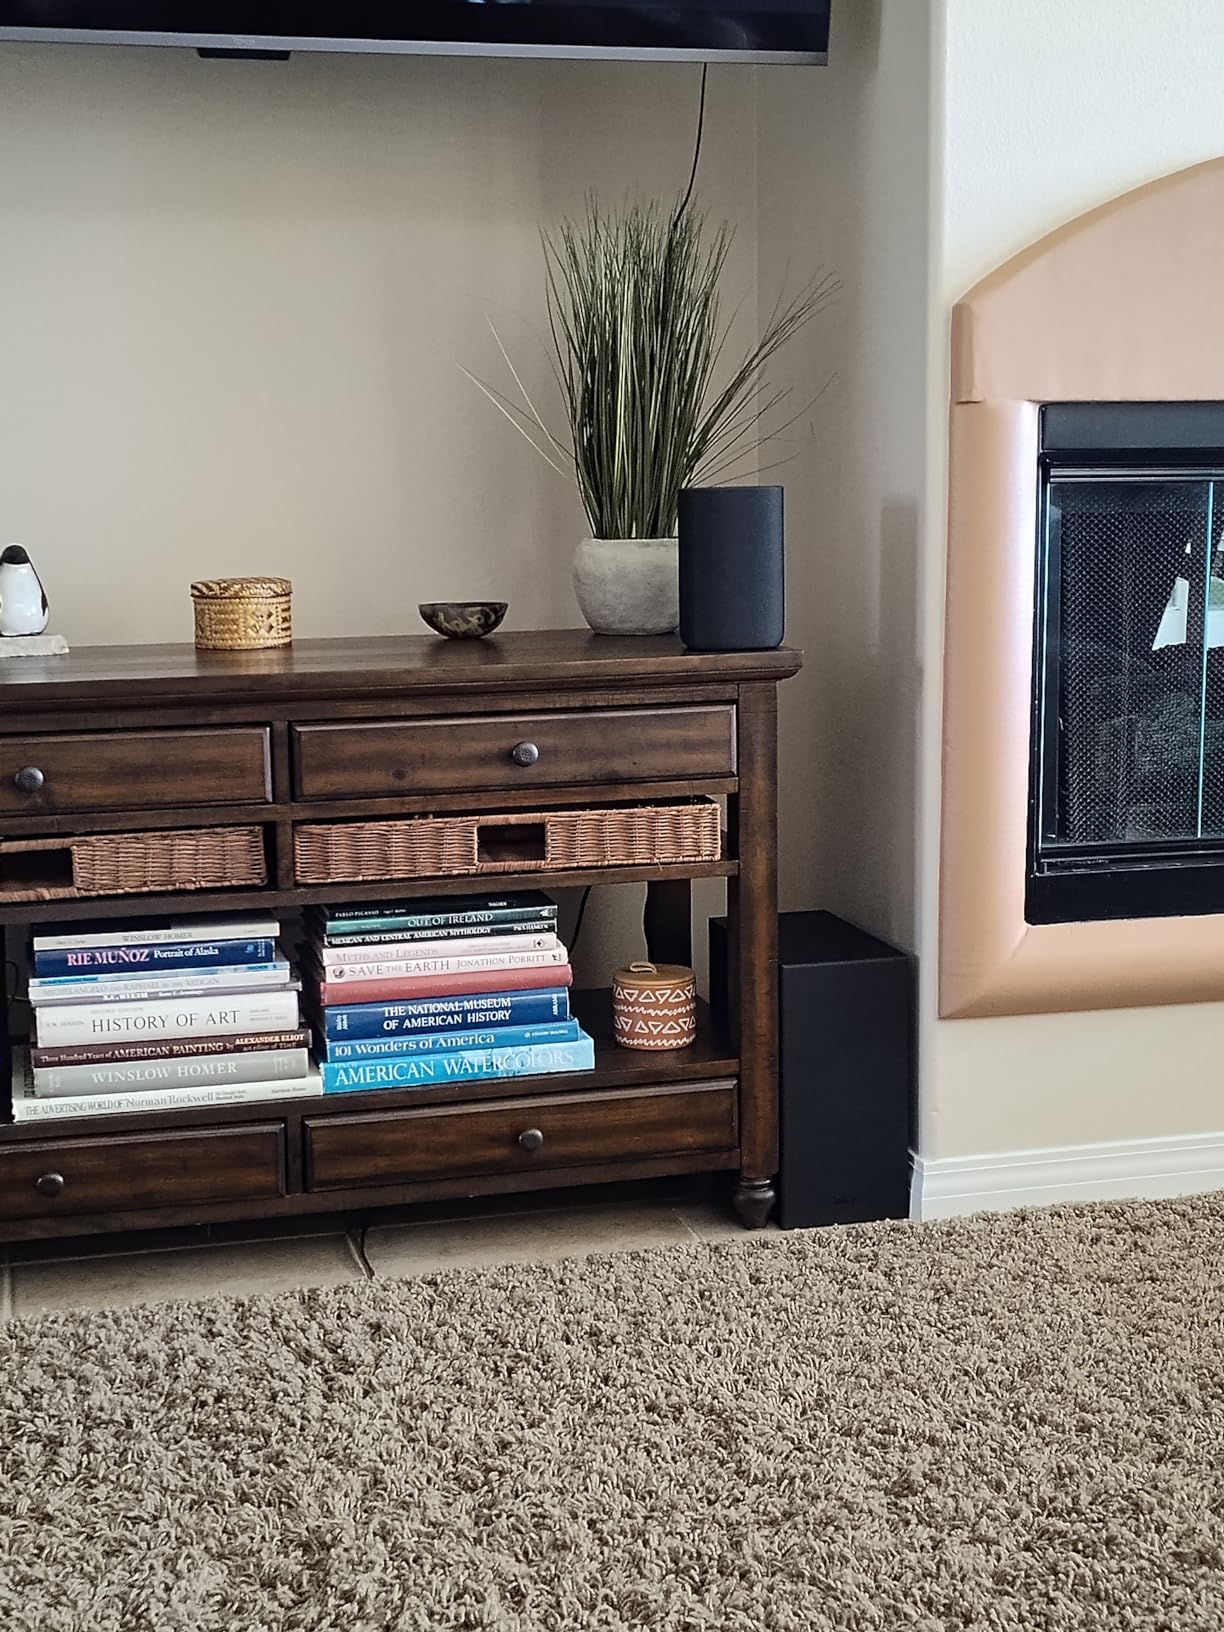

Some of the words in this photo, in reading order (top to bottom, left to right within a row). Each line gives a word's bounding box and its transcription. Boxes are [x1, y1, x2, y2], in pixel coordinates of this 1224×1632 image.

[354, 909, 380, 917] PICASSO
[407, 917, 431, 928] OUT
[431, 917, 446, 925] OF
[448, 913, 494, 924] IRELAND
[122, 934, 161, 942] WINSLOW
[164, 932, 193, 941] HOMER
[331, 936, 361, 945] MEXICAN
[363, 935, 380, 943] AND
[381, 932, 412, 942] CENTRAL
[412, 929, 448, 940] AMERICAN
[449, 926, 492, 937] MYTHOLOGY
[67, 952, 93, 966] RIE
[94, 947, 150, 964] MUÑOZ
[153, 949, 185, 959] Portrait
[185, 947, 195, 957] of
[194, 947, 219, 956] Alaska
[456, 957, 507, 969] JONATHON
[508, 954, 545, 964] PORRITT
[348, 964, 384, 977] SAVE
[386, 964, 404, 973] THE
[405, 960, 450, 973] EARTH
[185, 977, 220, 986] VATICAN
[384, 1006, 406, 1017] THE
[408, 1001, 464, 1015] NATIONAL
[463, 998, 512, 1011] MUSEUM
[92, 1015, 168, 1033] HISTORY
[176, 1013, 199, 1027] OF
[206, 1010, 240, 1025] ART
[383, 1019, 399, 1030] OF
[403, 1013, 462, 1029] AMERICAN
[467, 1010, 512, 1023] HISTORY
[235, 1034, 280, 1045] ALEXANDER
[281, 1033, 305, 1042] ELIOT
[335, 1046, 353, 1057] 101
[355, 1041, 417, 1055] Wonders
[419, 1038, 432, 1049] of
[435, 1034, 495, 1049] America
[113, 1046, 170, 1059] AMERICAN
[172, 1043, 224, 1054] PAINTING
[92, 1066, 170, 1083] WINSLOW
[177, 1061, 238, 1078] HOMER
[335, 1060, 435, 1086] AMERICAN
[443, 1049, 574, 1076] WATERCOLORS
[25, 1106, 41, 1116] THE
[42, 1102, 87, 1114] ADVERTISING
[88, 1101, 113, 1111] WORLD
[113, 1099, 123, 1109] OF
[125, 1098, 167, 1108] Norman
[167, 1092, 213, 1105] Rockwell
